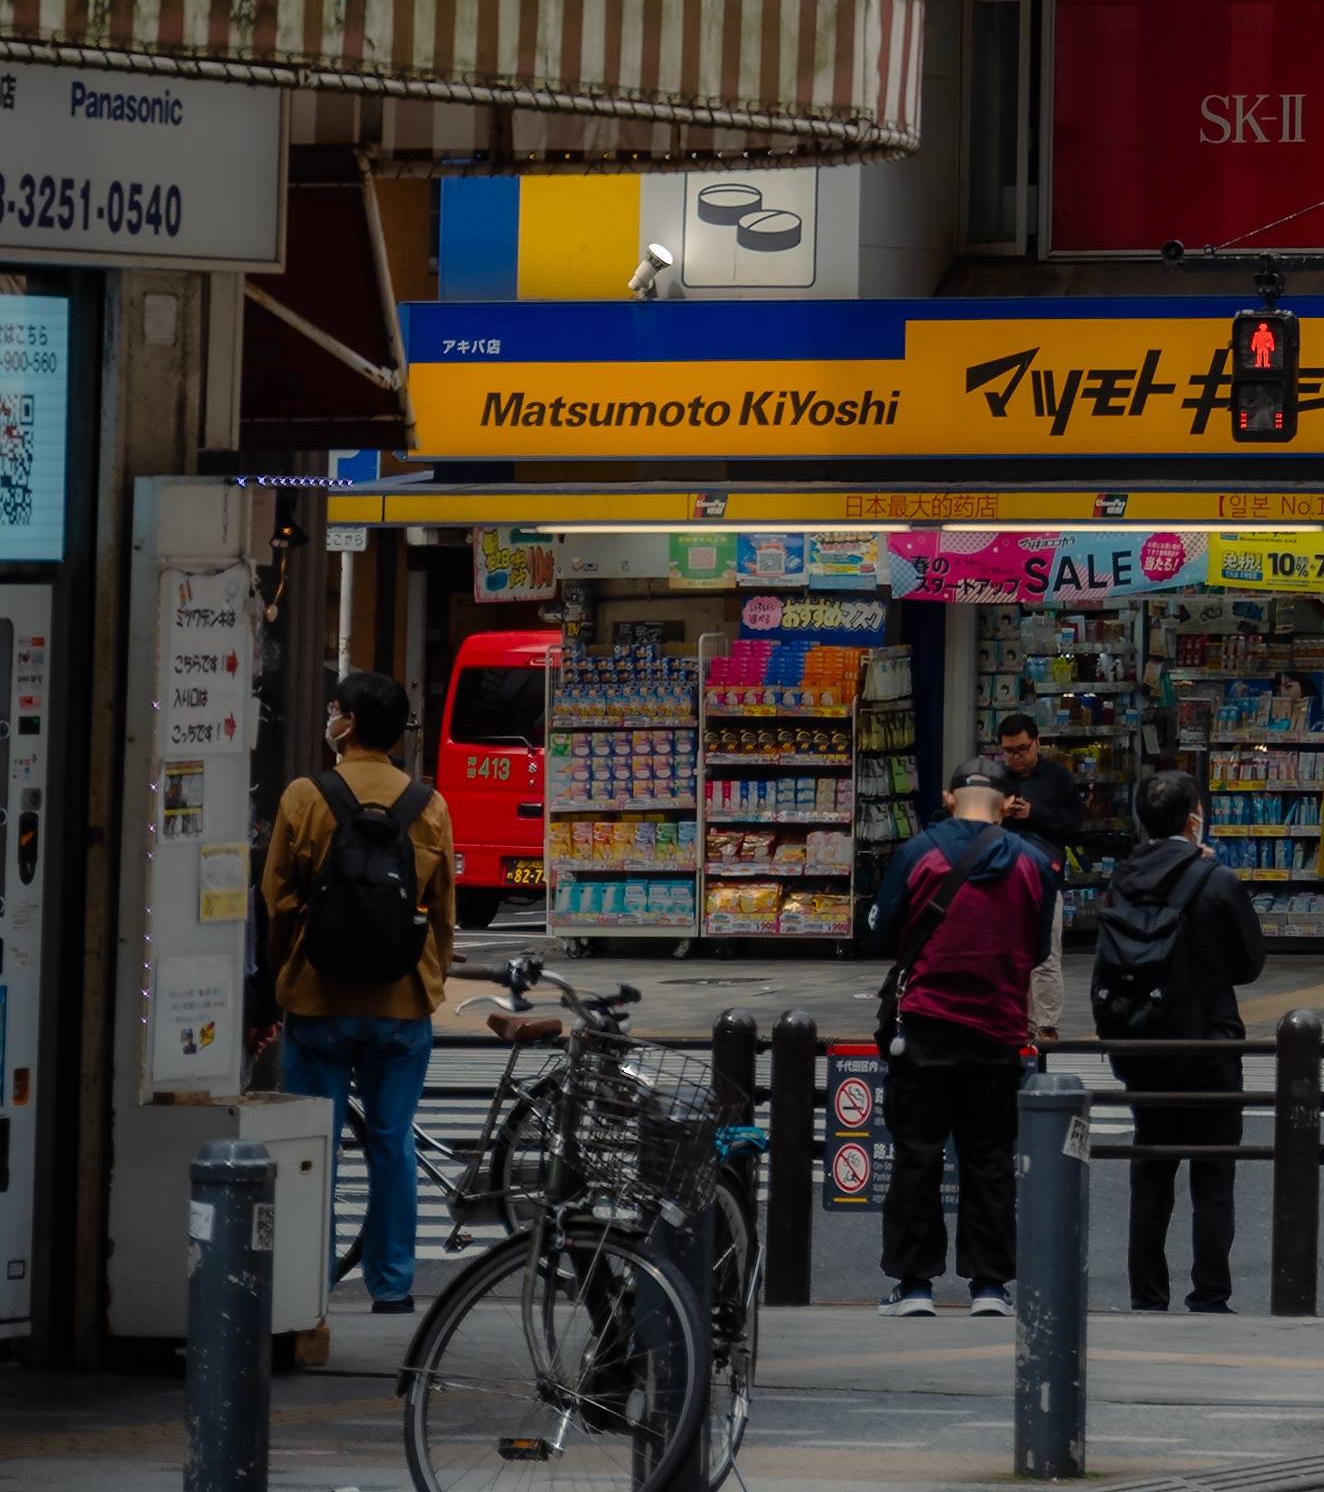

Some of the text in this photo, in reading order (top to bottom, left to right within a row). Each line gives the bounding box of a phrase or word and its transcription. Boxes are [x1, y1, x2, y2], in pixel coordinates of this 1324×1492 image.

[71, 81, 183, 126] Panasonic
[1200, 93, 1306, 144] SK-II
[441, 338, 500, 356] アキバ店
[480, 390, 900, 428] Matsumoto KiYoshi
[845, 494, 998, 519] 日本最大的药店
[911, 554, 951, 575] 春の
[1025, 550, 1133, 594] SALE
[478, 755, 509, 780] 413
